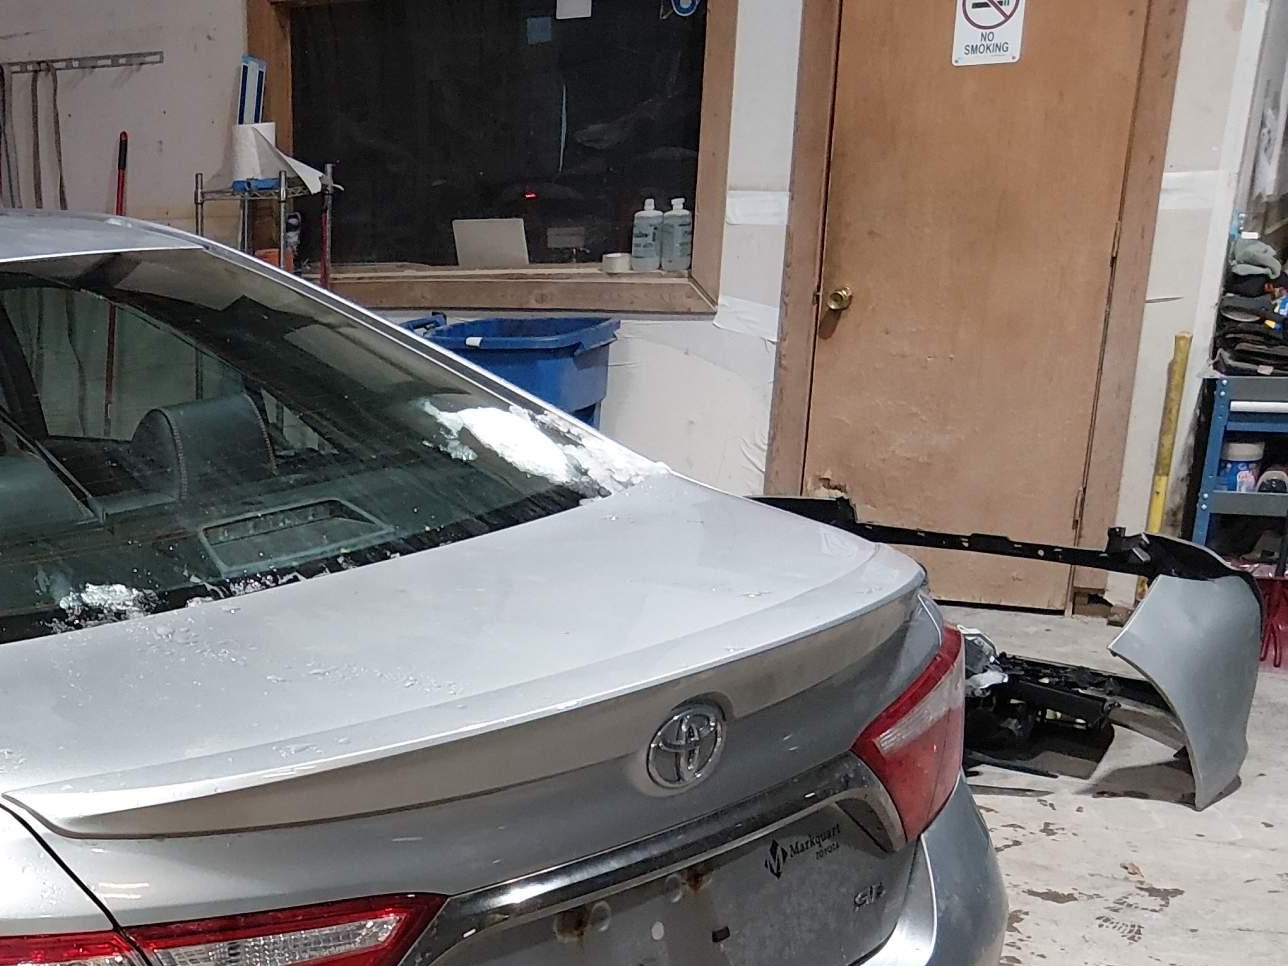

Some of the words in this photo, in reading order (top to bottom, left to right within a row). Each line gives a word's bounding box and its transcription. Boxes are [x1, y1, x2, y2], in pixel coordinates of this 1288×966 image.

[980, 31, 995, 42] NO
[963, 42, 1009, 56] SMOKING
[789, 823, 841, 858] Markquart
